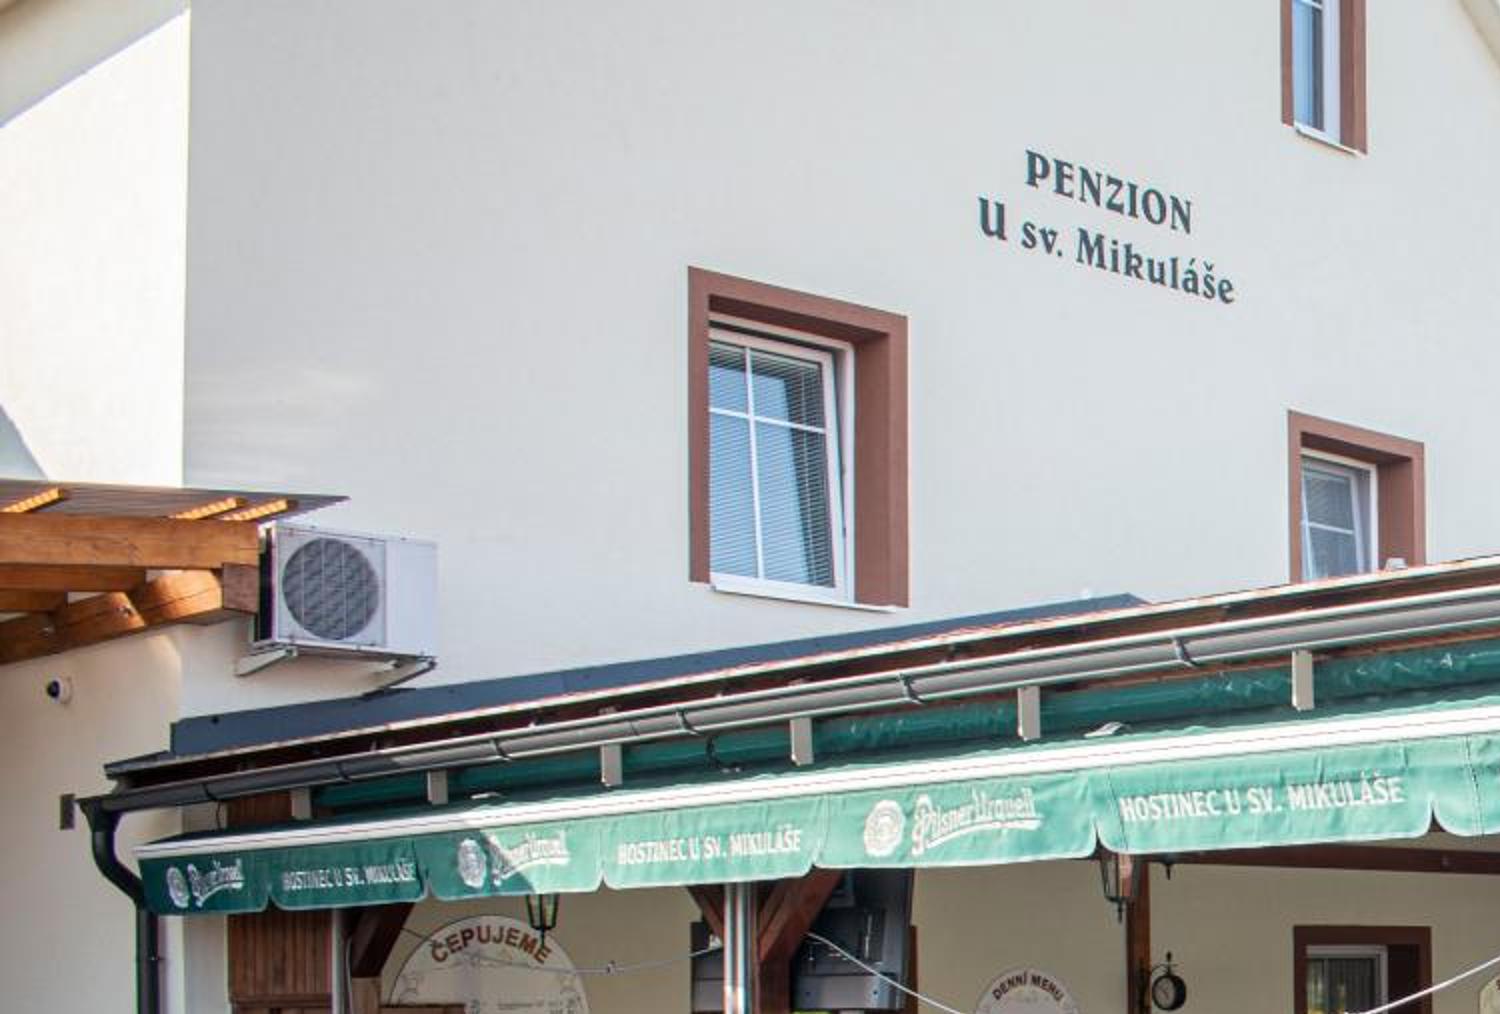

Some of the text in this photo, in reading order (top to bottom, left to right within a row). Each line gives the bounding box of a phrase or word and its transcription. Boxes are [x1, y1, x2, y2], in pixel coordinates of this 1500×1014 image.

[1025, 149, 1192, 235] PENZION
[977, 196, 1236, 305] U sv. Mikuláše
[1118, 768, 1407, 822] HOSTINEC U SV. MIKULÁŠE
[430, 924, 553, 964] ČEPUJEME
[992, 970, 1065, 1002] DENNÍ MENU
